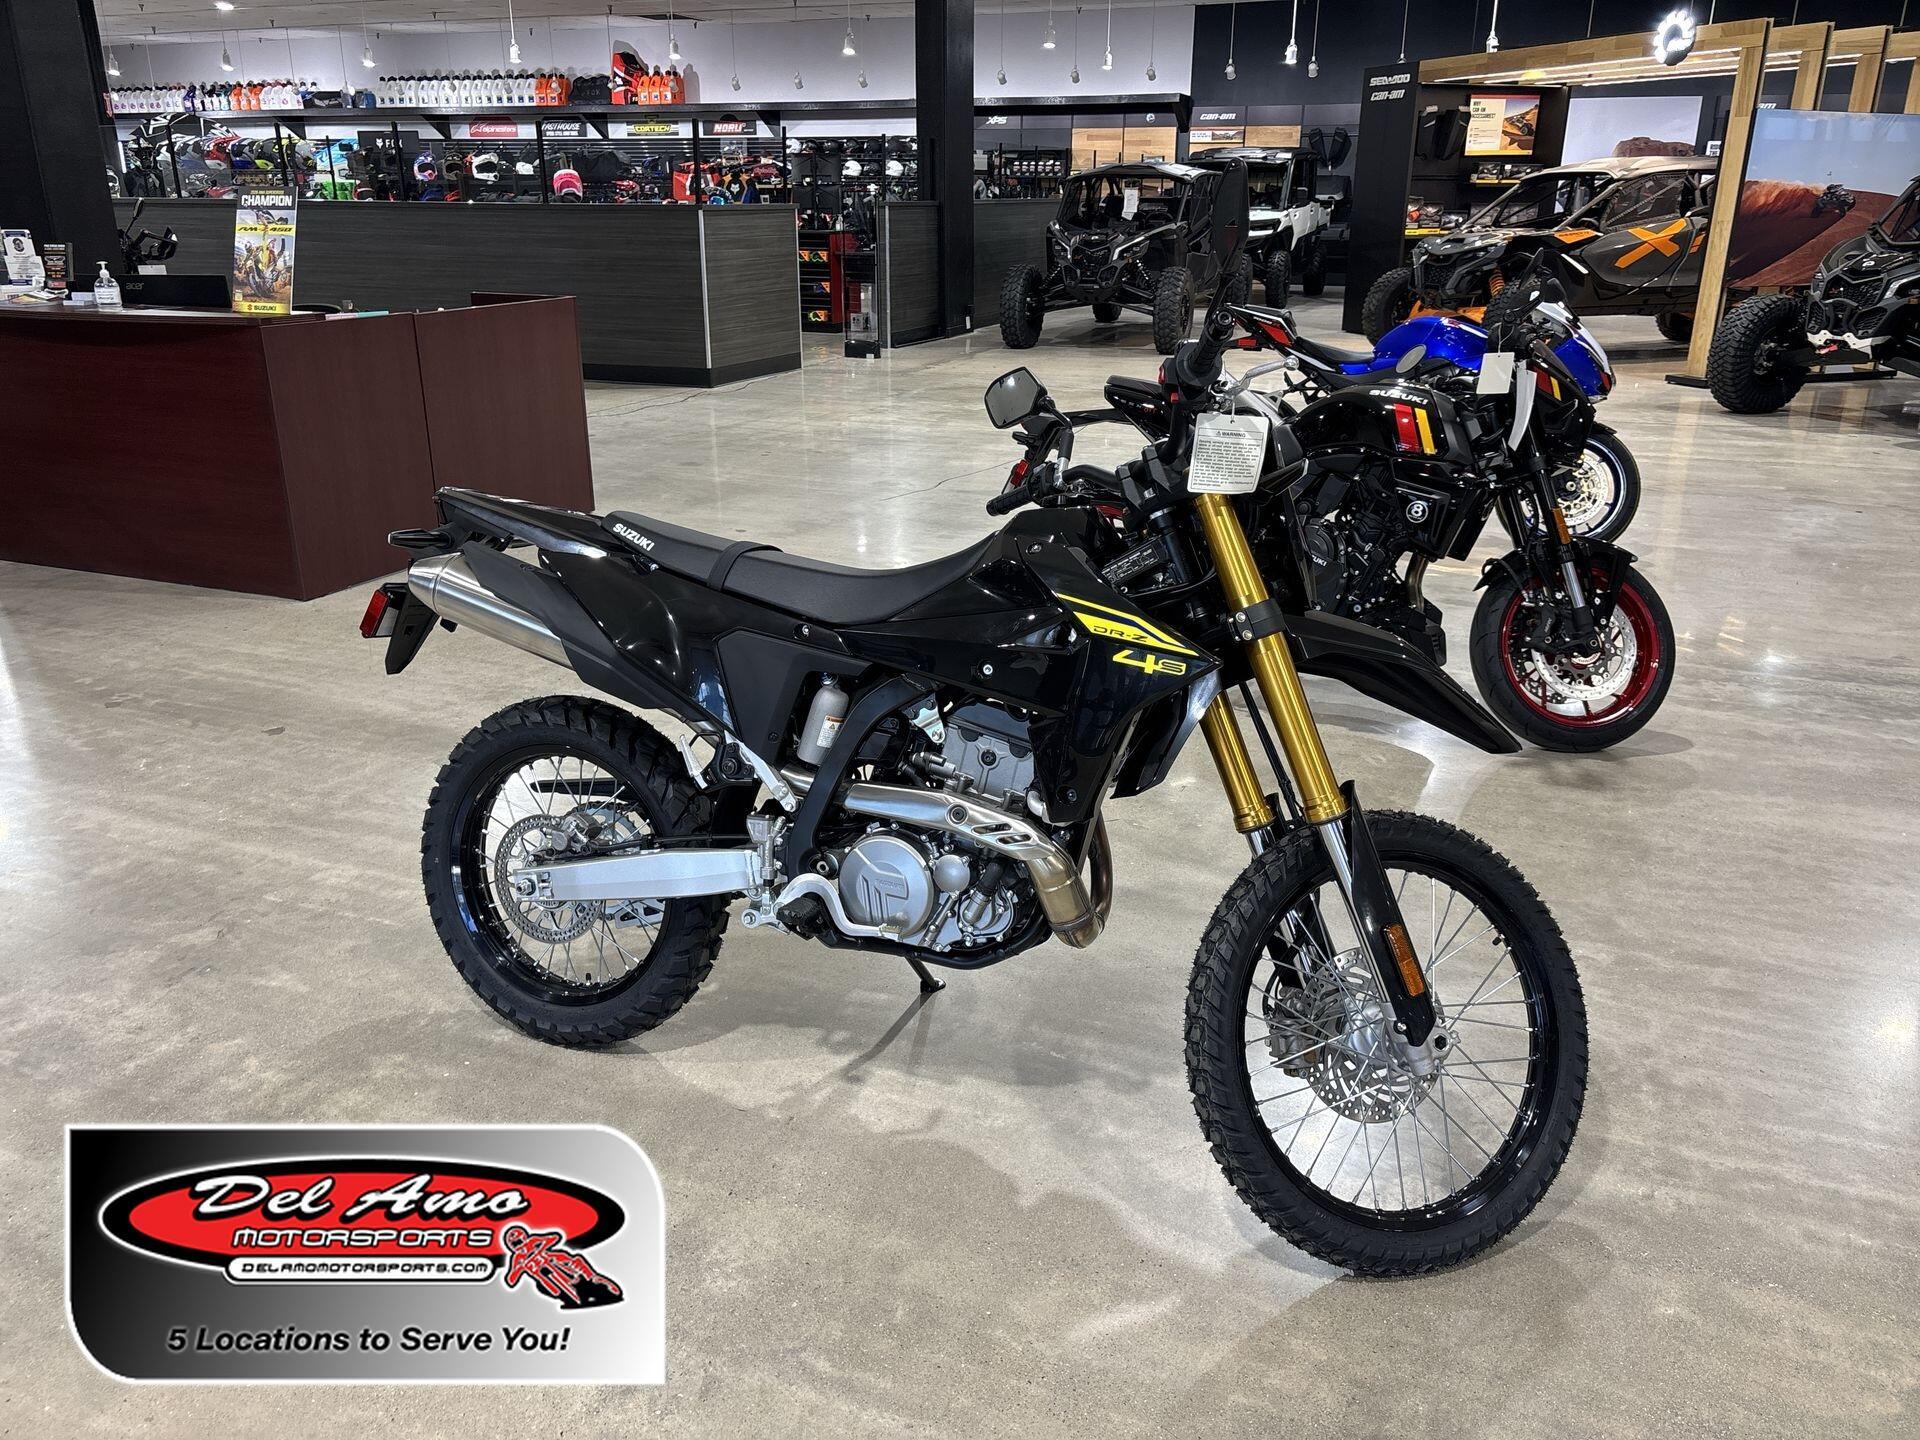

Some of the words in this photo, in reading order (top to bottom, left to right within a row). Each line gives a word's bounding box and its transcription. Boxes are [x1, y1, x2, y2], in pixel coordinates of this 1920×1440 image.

[241, 195, 292, 206] CHAMPION
[126, 282, 144, 290] acer
[1369, 389, 1429, 405] SUZUKI
[612, 523, 655, 551] SUZUKI
[1093, 625, 1149, 643] DR-Z
[1112, 649, 1187, 676] 4S
